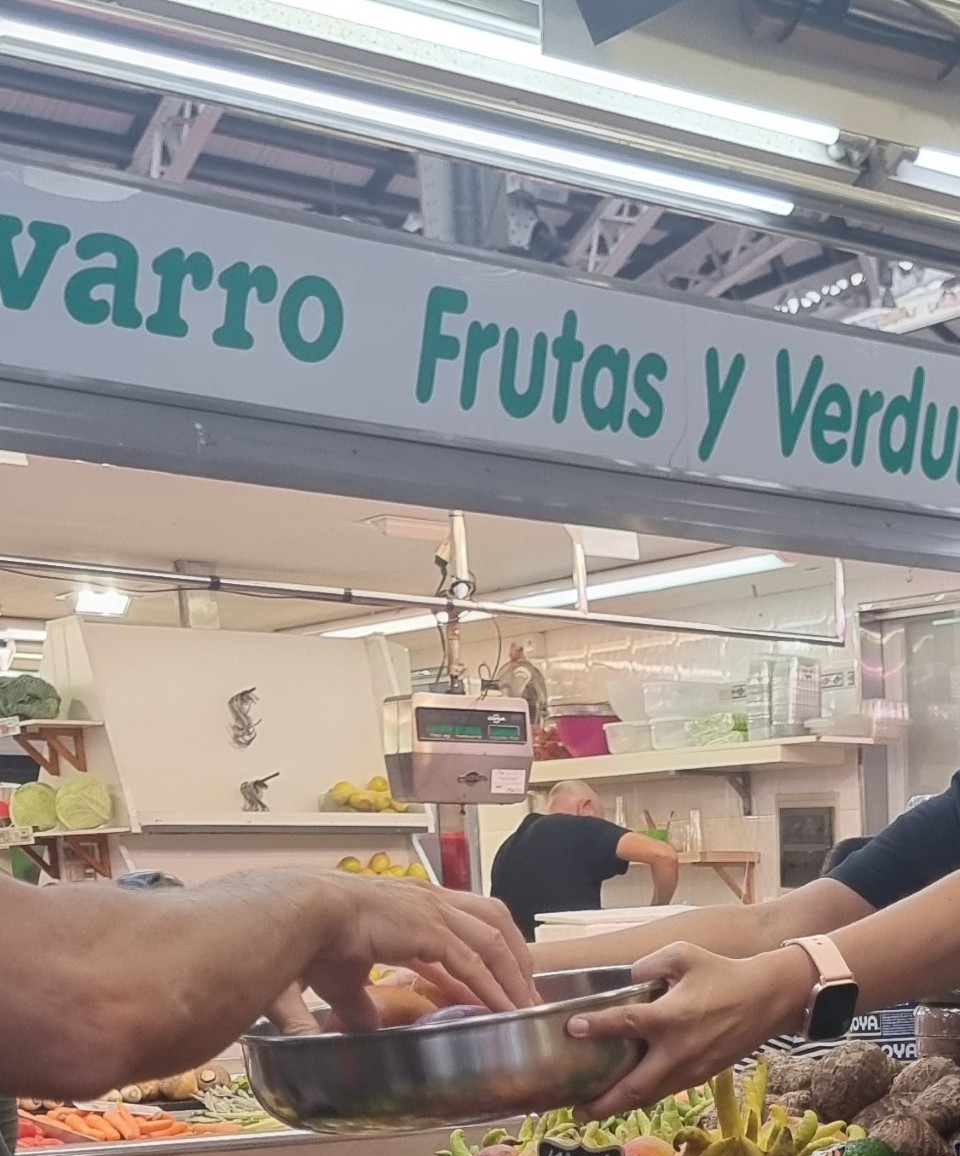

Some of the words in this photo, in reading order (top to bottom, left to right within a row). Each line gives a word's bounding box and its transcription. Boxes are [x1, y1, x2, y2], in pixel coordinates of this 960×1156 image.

[0, 213, 344, 363] varro
[416, 286, 668, 438] Frutas
[698, 347, 746, 462] y
[850, 1015, 880, 1032] OYA
[881, 1043, 918, 1058] OYA
